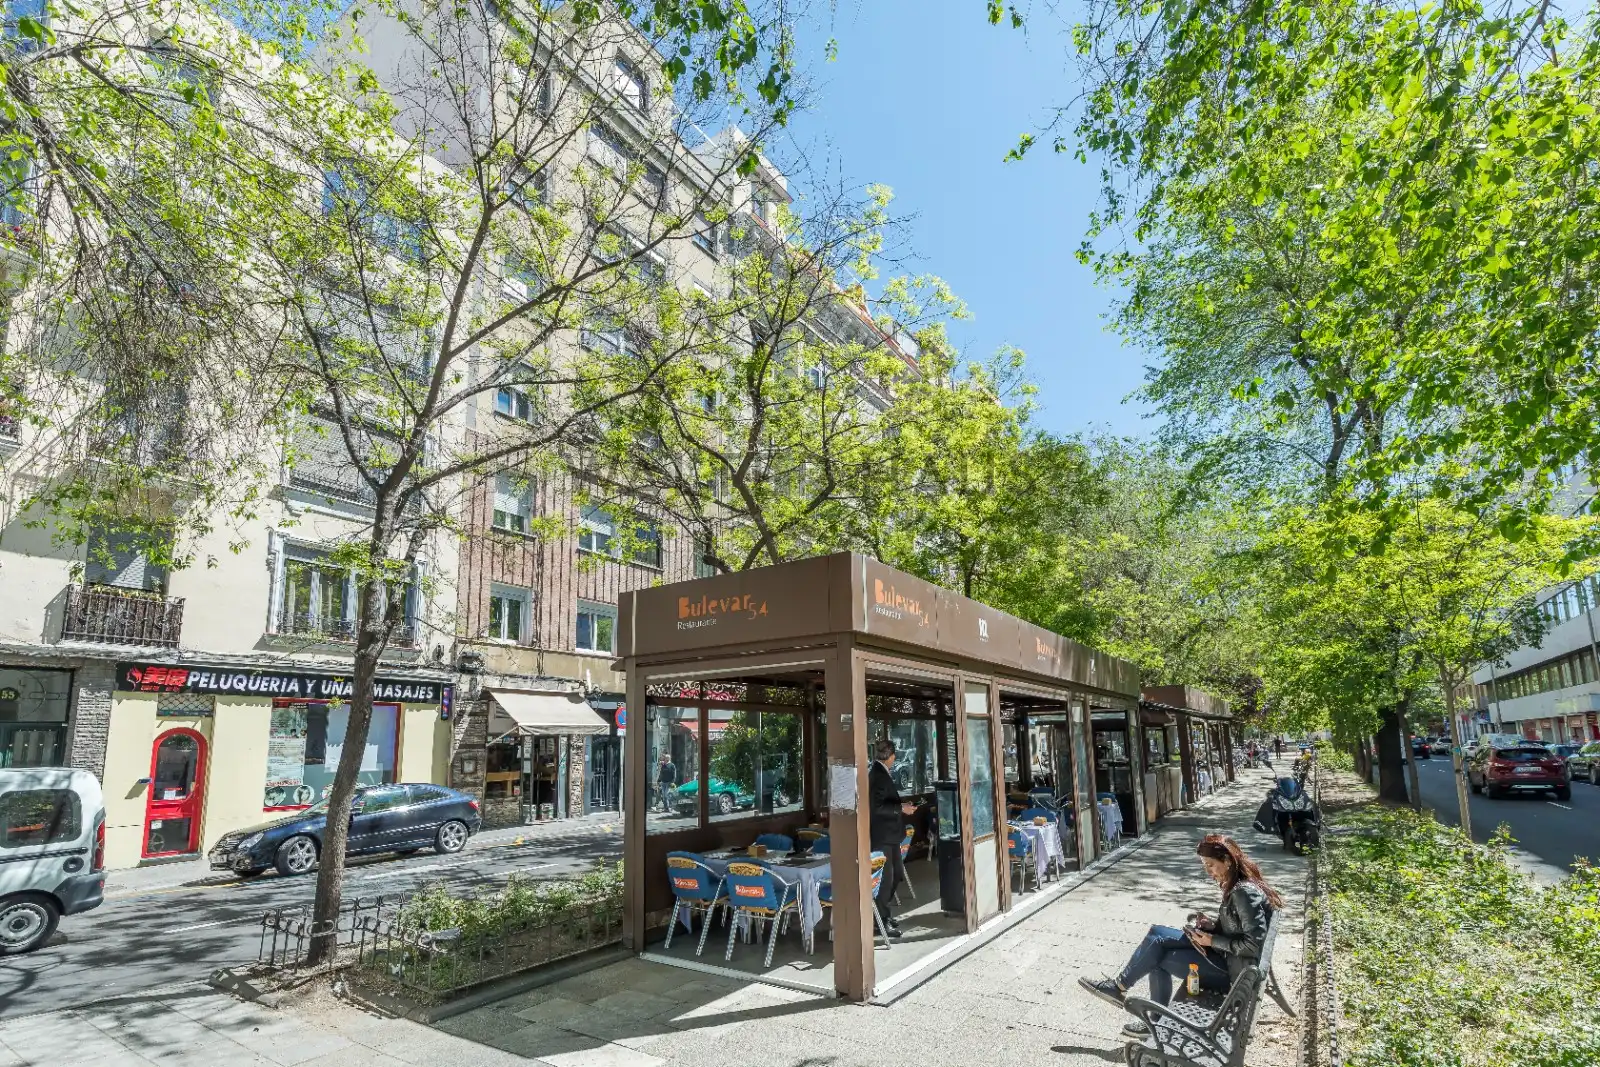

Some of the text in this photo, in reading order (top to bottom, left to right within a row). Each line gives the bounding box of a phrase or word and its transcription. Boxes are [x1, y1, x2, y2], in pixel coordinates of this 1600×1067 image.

[678, 594, 769, 620] Bulevar 54
[874, 578, 920, 616] Bulevar
[305, 677, 317, 694] Y
